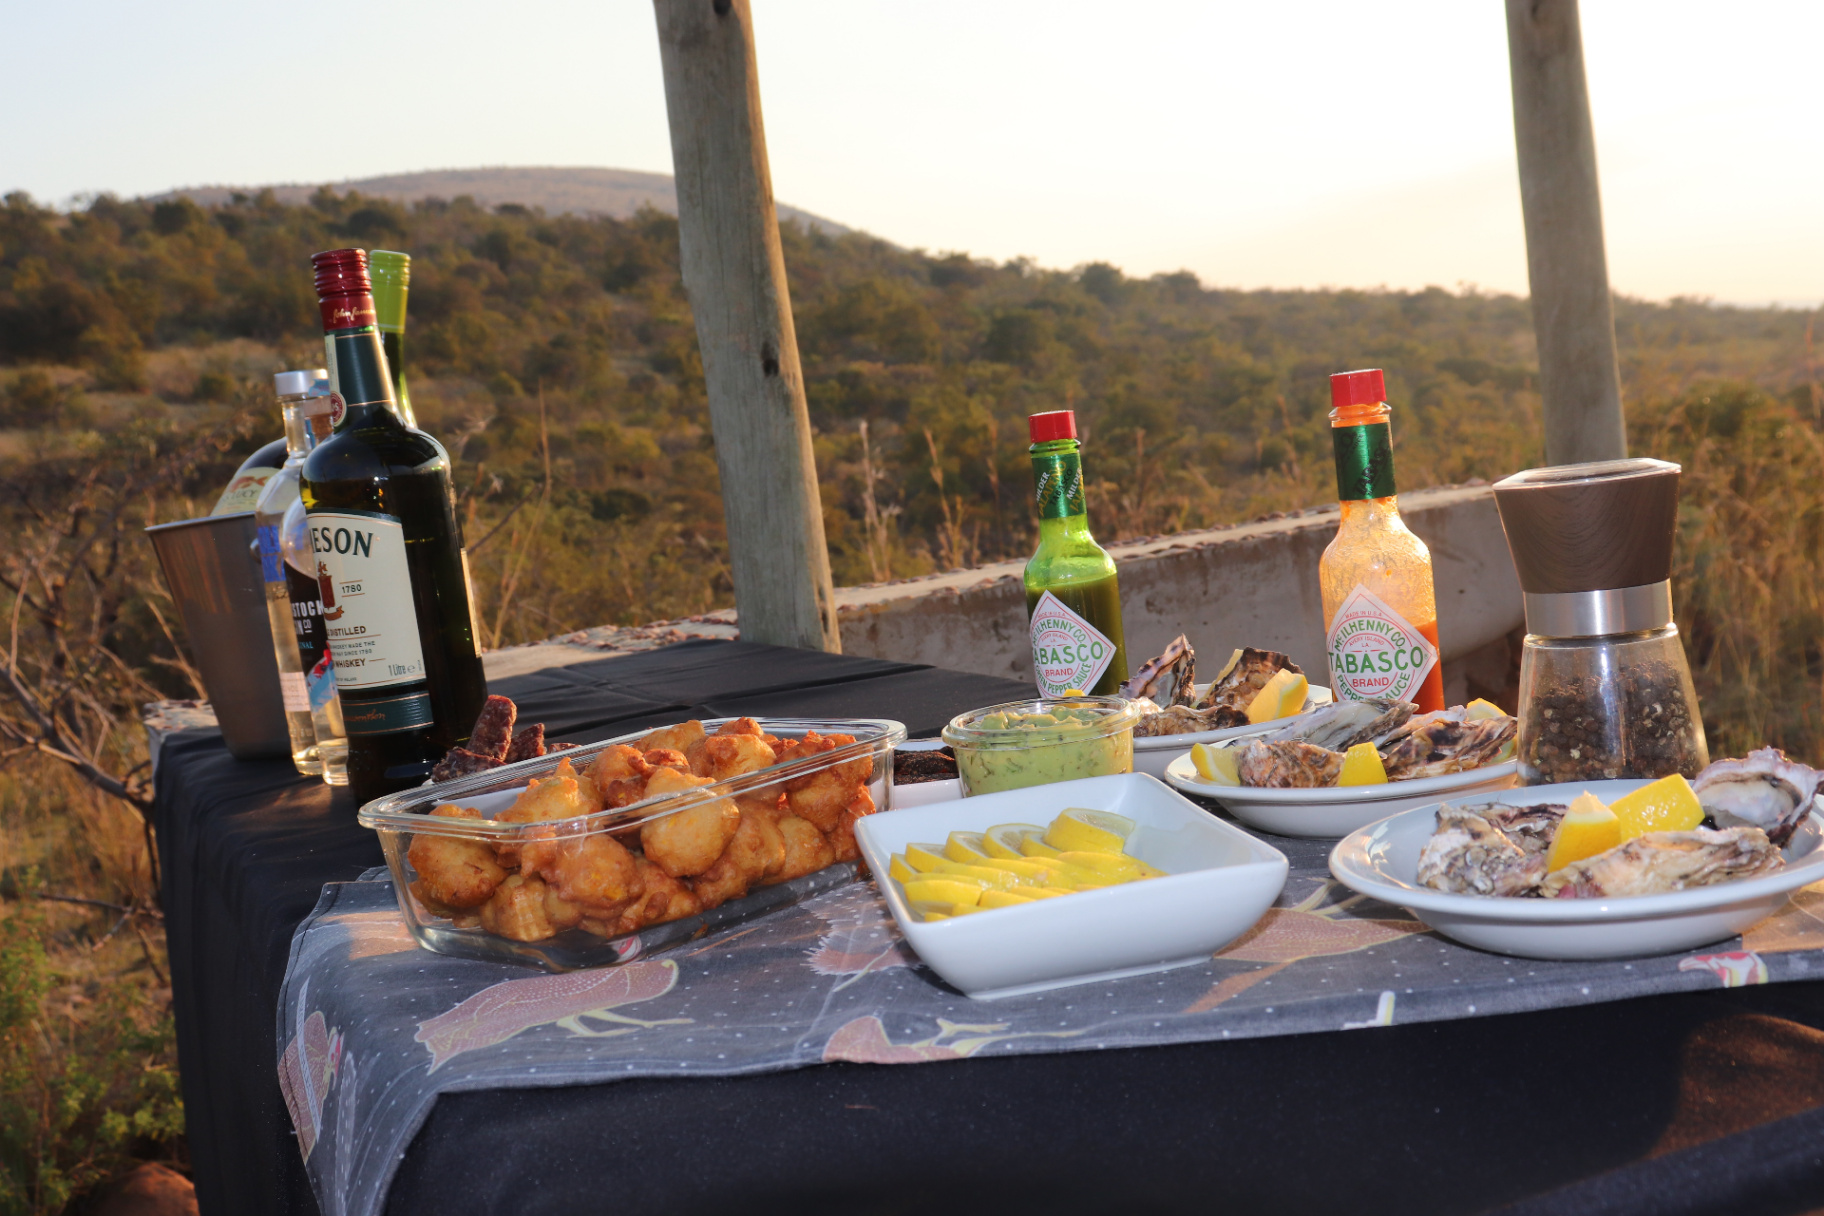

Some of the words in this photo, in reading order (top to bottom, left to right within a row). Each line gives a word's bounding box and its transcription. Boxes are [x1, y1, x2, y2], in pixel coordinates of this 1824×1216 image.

[310, 527, 373, 558] ESON
[341, 583, 362, 594] 1780
[291, 600, 323, 618] STOCK
[364, 640, 376, 648] THE
[1349, 636, 1364, 647] AVERY
[1364, 635, 1385, 646] ISLAND
[1032, 641, 1103, 665] ABASCO
[335, 658, 366, 669] WHISKEY
[1328, 646, 1424, 674] TABASCO
[1045, 668, 1073, 677] BRAND
[1072, 662, 1092, 687] SAUCE
[1352, 677, 1390, 688] BRAND
